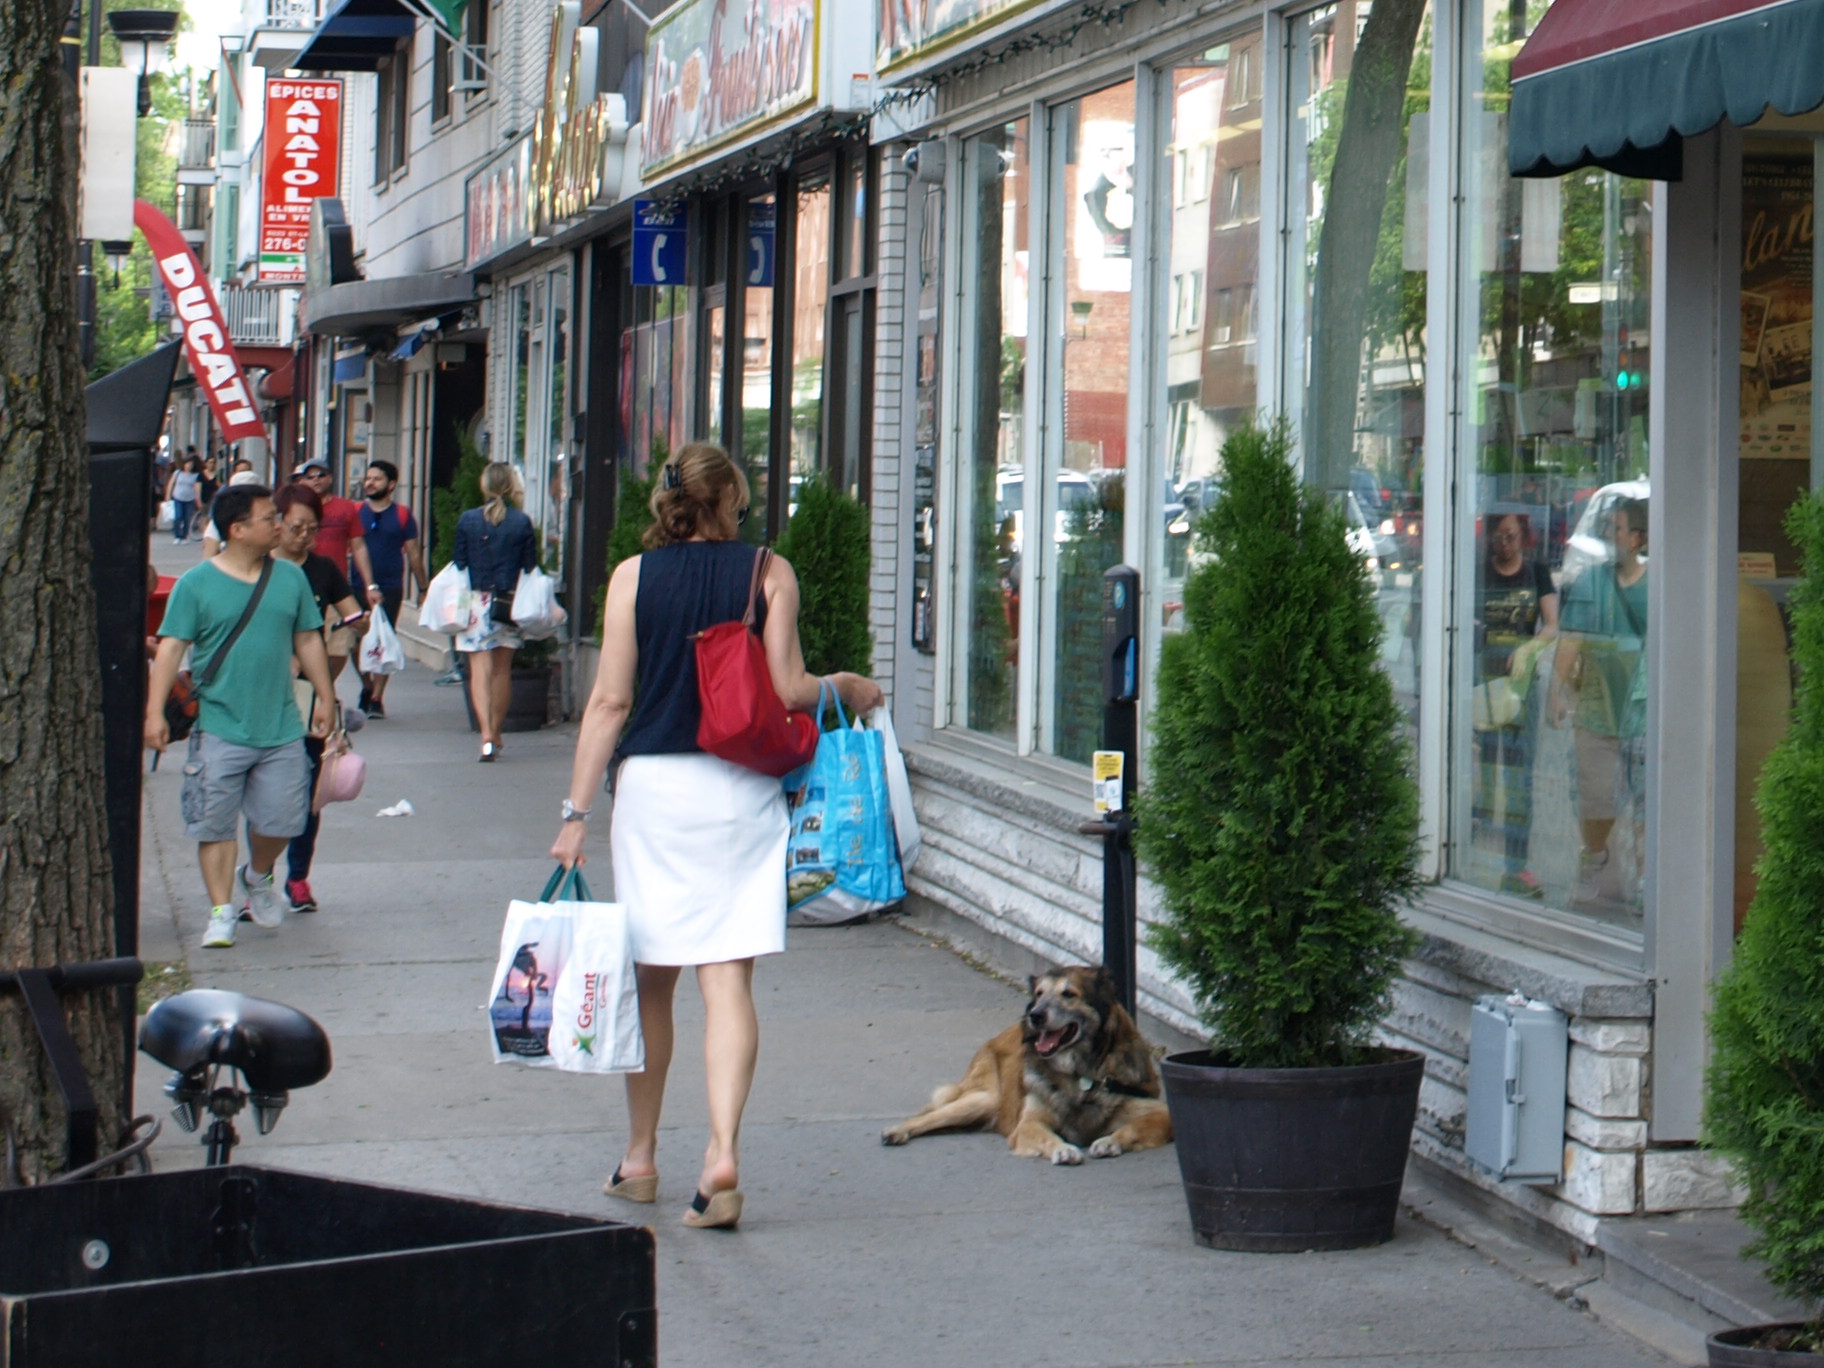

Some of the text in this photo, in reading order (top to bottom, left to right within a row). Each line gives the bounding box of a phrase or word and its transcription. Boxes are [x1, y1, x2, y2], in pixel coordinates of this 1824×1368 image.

[270, 82, 338, 100] ÉPICES
[160, 251, 256, 427] DUCATI
[577, 972, 597, 1029] Géant
